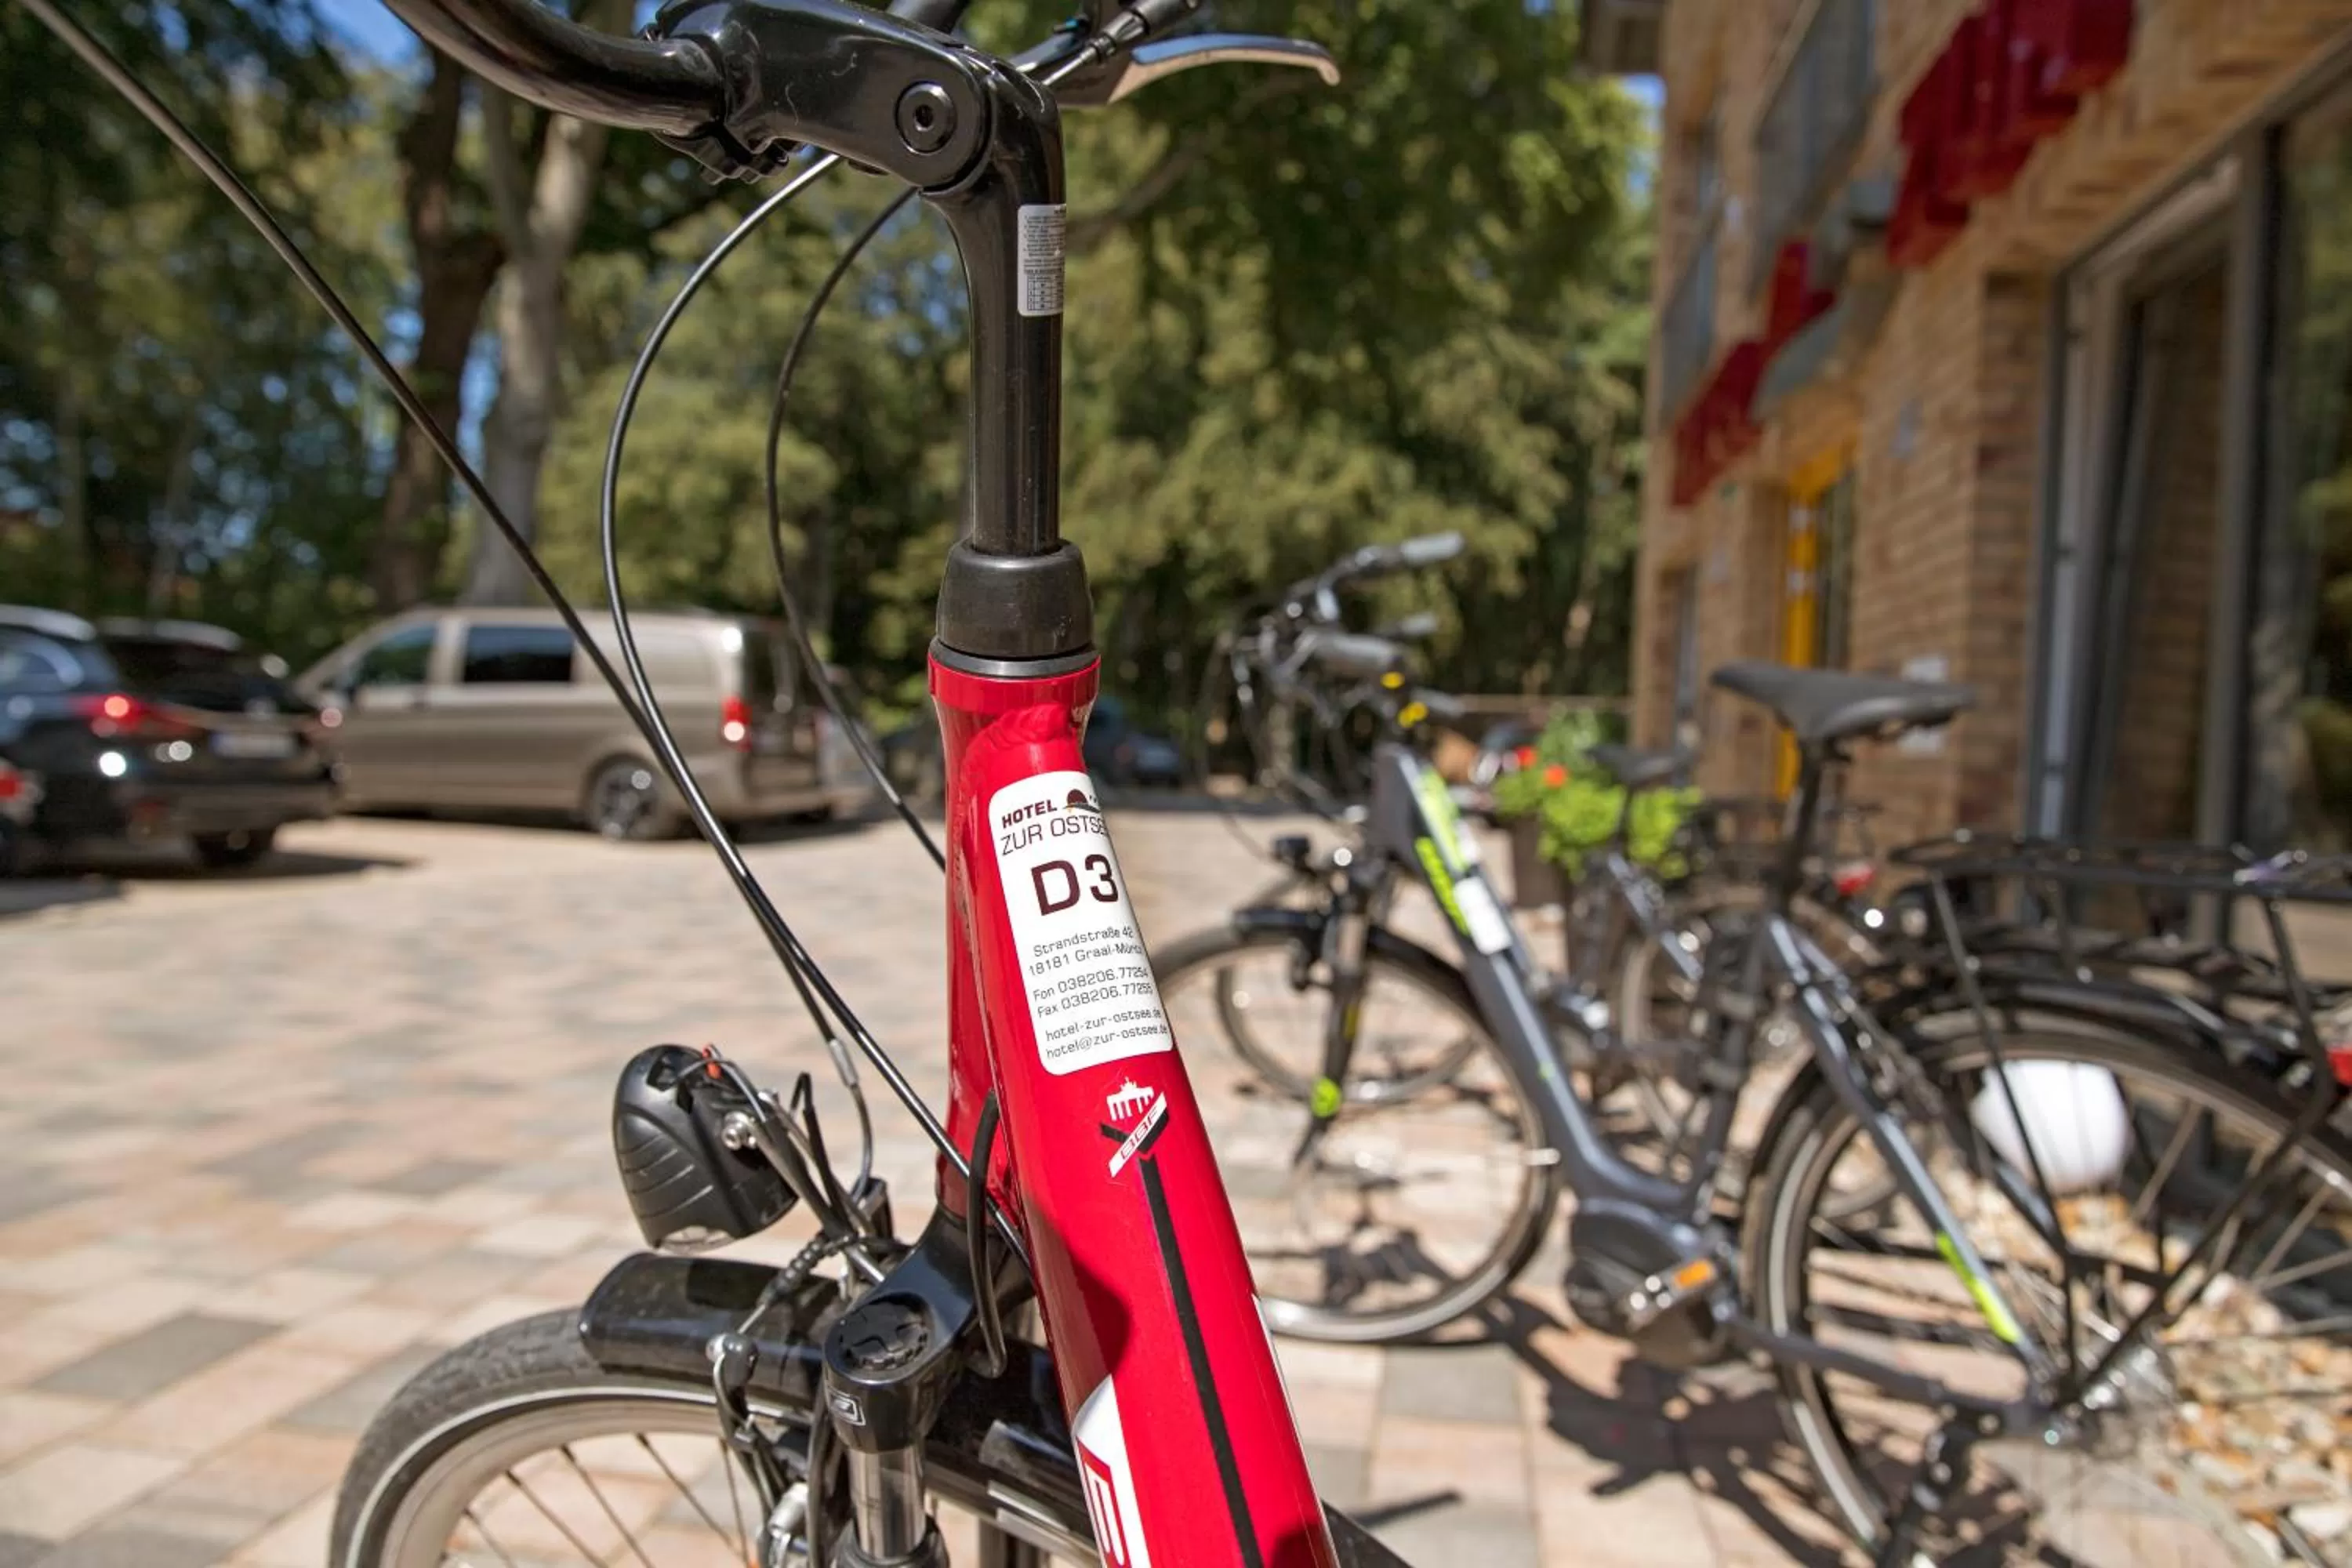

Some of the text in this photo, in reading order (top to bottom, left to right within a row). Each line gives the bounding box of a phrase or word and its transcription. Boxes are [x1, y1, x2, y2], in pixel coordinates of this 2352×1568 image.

[1001, 800, 1058, 829] HOTEL
[1000, 823, 1044, 856] ZUR
[1033, 927, 1120, 957] Strandstraße
[1029, 954, 1070, 976] 18181
[1033, 988, 1055, 1002] Fon
[1037, 983, 1153, 1018] Fax 038206.77255
[1046, 1007, 1161, 1041] hotel-zur-ostsee.de
[1046, 1024, 1167, 1059] hotel@zur-ostsee.de
